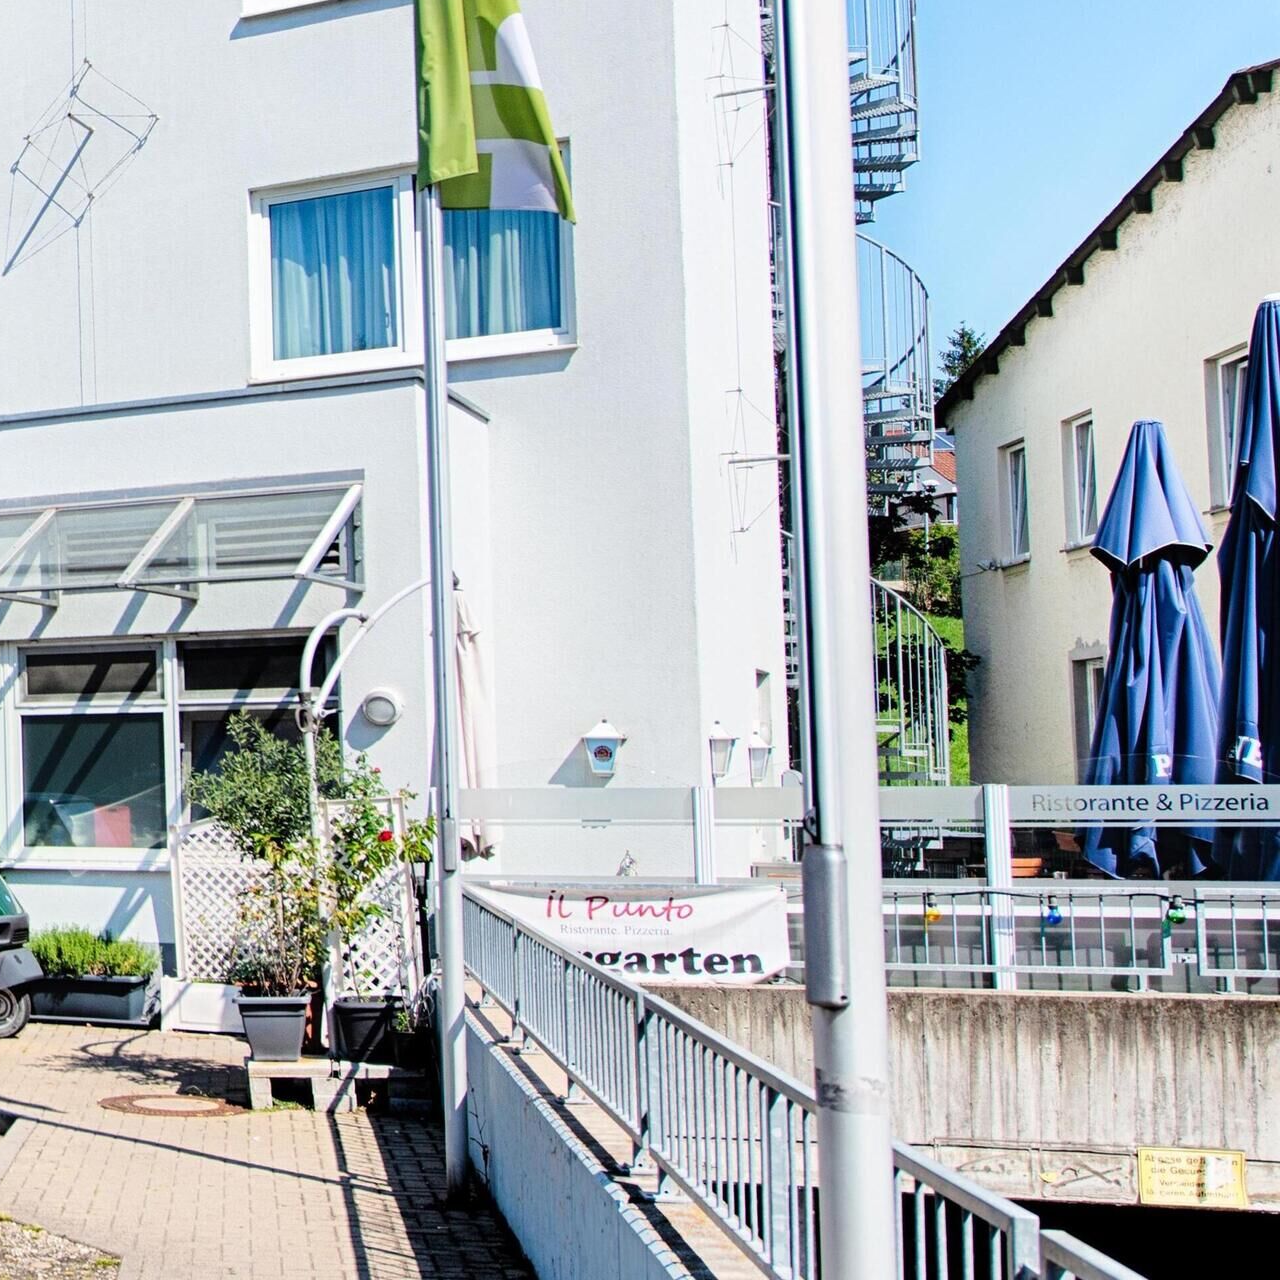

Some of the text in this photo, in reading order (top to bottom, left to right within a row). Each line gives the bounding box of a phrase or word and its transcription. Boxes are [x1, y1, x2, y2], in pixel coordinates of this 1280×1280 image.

[1032, 793, 1269, 811] Ristorante & Pizzeria
[586, 896, 694, 922] Punto
